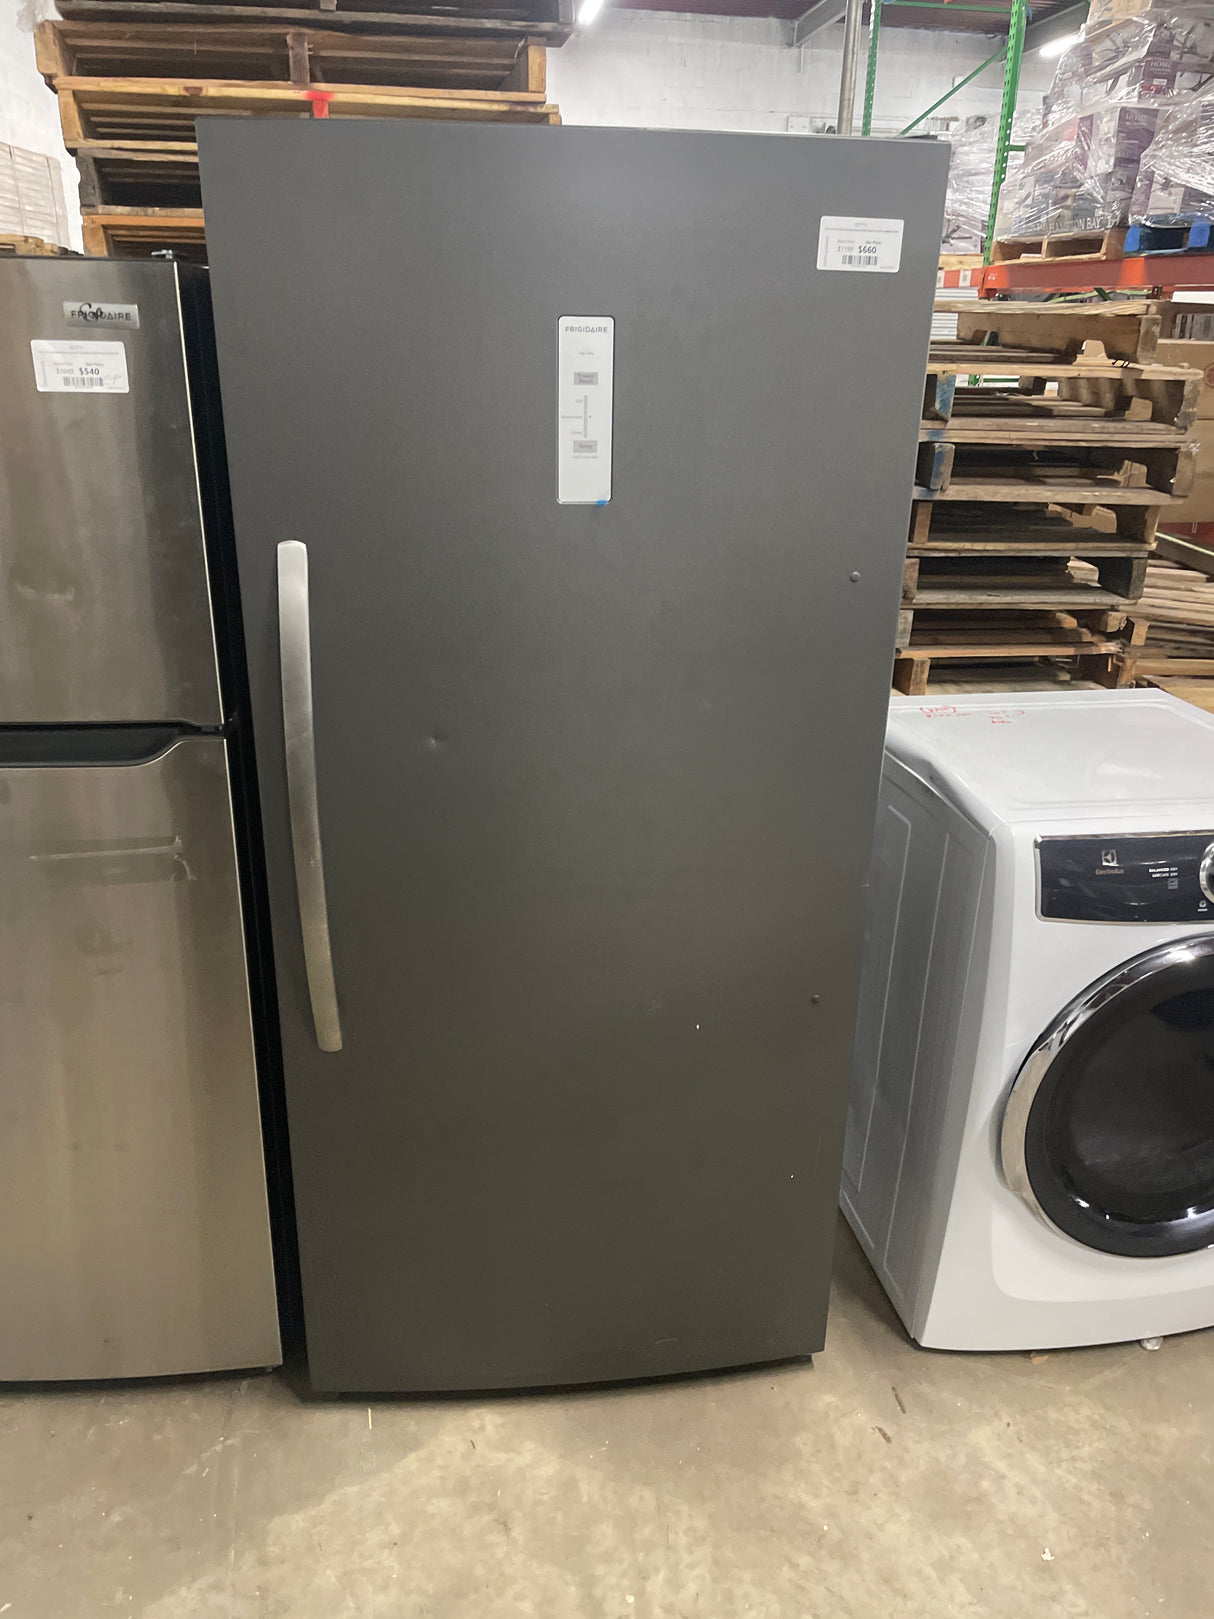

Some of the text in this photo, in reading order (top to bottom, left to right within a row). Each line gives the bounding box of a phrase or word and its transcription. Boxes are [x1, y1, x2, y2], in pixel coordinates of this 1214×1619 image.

[1087, 217, 1102, 230] BAY
[858, 245, 877, 254] $660
[71, 310, 132, 321] FRIGDAIRE
[79, 367, 100, 376] $540
